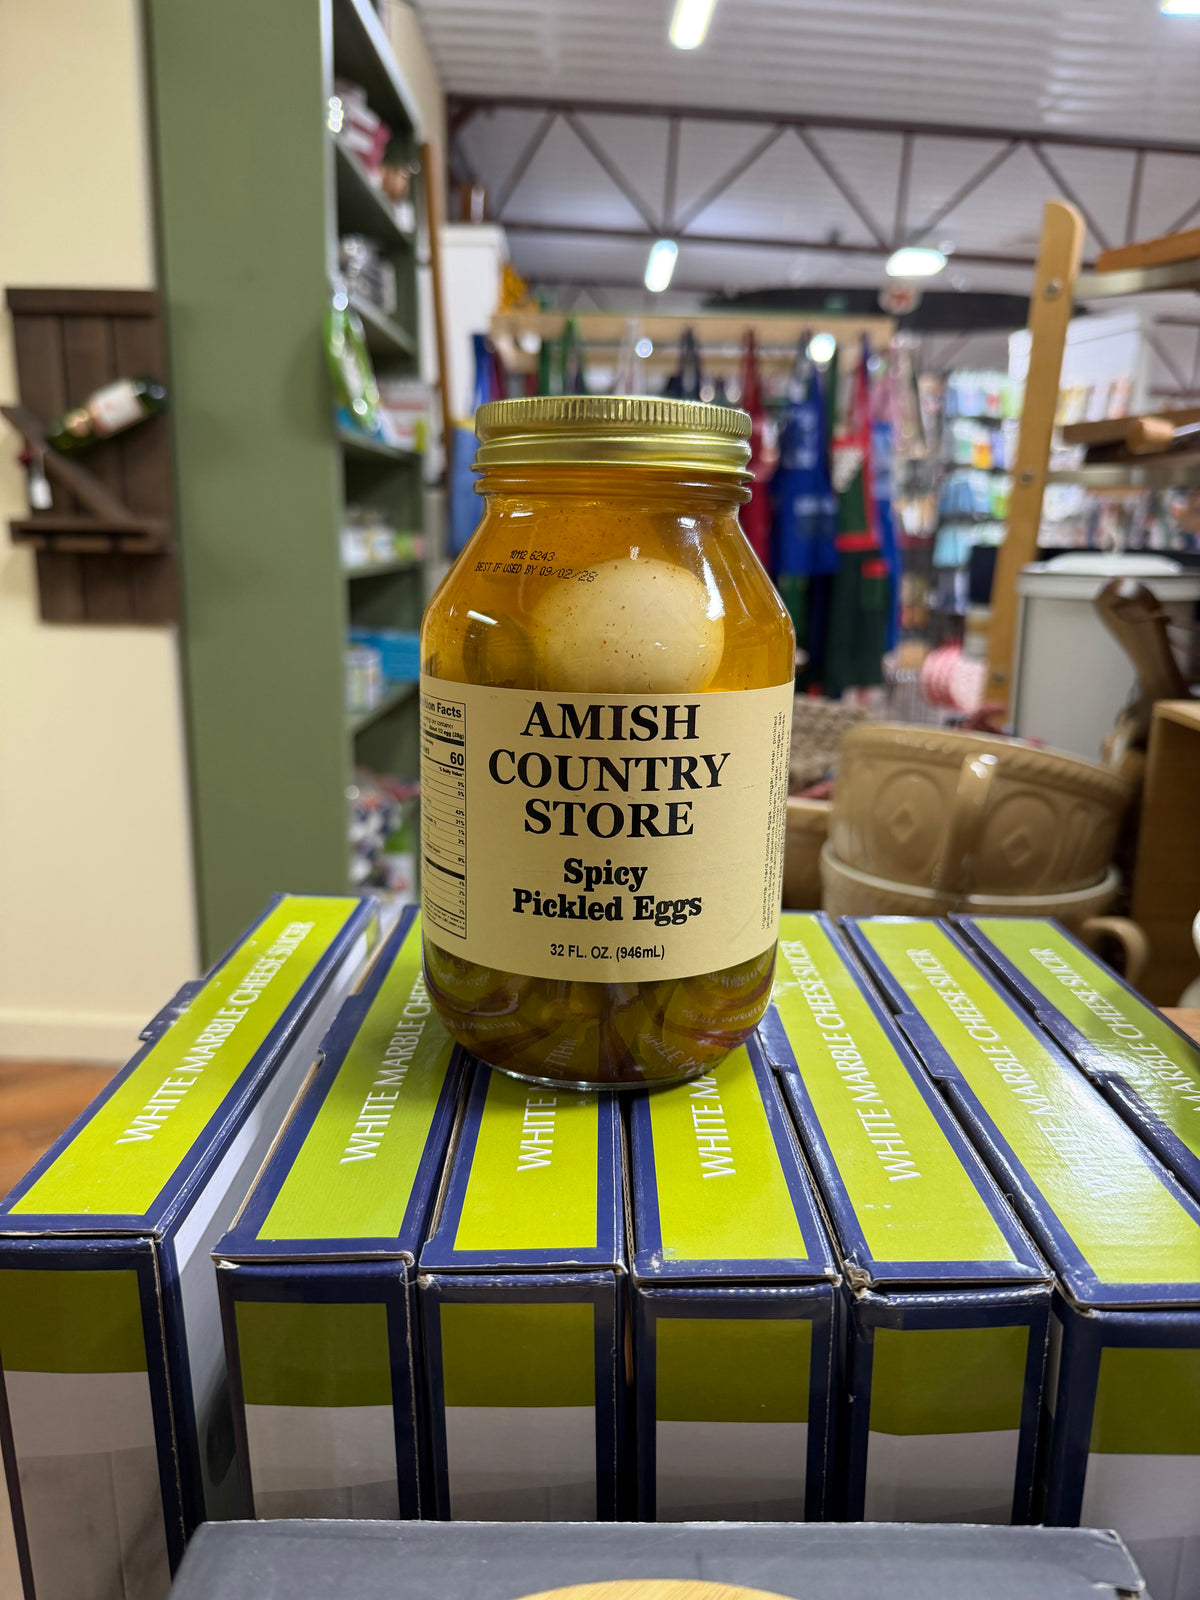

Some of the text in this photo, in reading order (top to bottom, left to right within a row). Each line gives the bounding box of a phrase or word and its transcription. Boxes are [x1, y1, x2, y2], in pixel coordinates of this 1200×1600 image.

[475, 562, 492, 572] BEST
[493, 563, 502, 573] IF
[503, 564, 522, 574] USED
[524, 565, 537, 576] BY
[530, 551, 555, 561] 6243
[437, 702, 462, 718] Facts
[520, 702, 700, 741] AMISH
[450, 751, 464, 766] 60
[489, 749, 731, 792] COUNTRY
[524, 799, 694, 838] STORE
[564, 857, 648, 893] Spicy
[512, 888, 702, 926] Pickled Eggs
[550, 943, 665, 962] 32 FL. OZ. (946mL)
[906, 949, 959, 988] SLICER
[1029, 948, 1089, 988] SLICER
[115, 921, 315, 1144] WHITE MARBLE CHEESE SLICER
[937, 987, 999, 1041] CHEESE
[1069, 988, 1143, 1038] CHEESE
[780, 940, 921, 1182] WHITE MARBLE CHEESE SLICER
[979, 1045, 1060, 1116] MARBLE
[340, 1091, 399, 1164] WHITE
[373, 1020, 425, 1086] MARBLE
[517, 1098, 556, 1171] WHITE
[691, 1104, 736, 1179] WHITE
